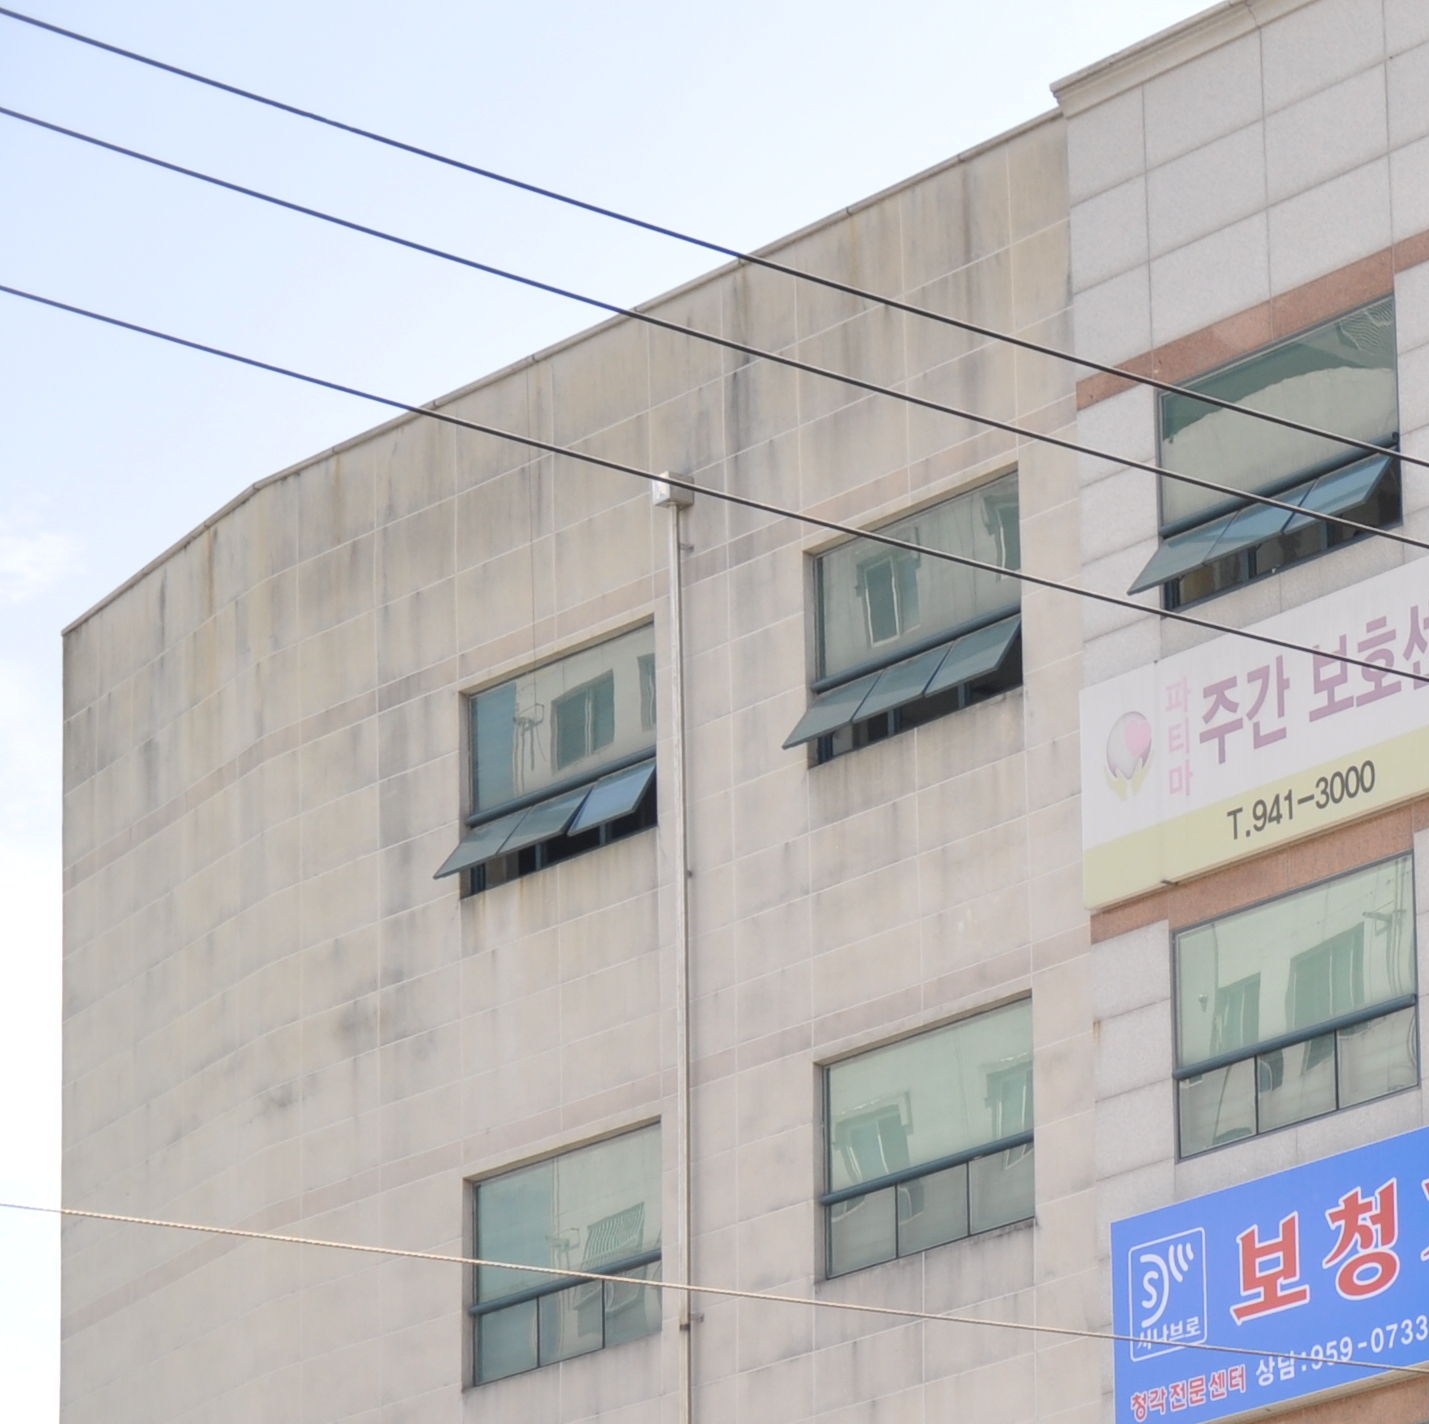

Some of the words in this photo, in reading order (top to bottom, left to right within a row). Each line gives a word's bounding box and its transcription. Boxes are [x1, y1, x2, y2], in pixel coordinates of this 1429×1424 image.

[1165, 675, 1194, 797] 파티마
[1200, 655, 1291, 765] 주간
[1227, 760, 1376, 841] T.941-3000
